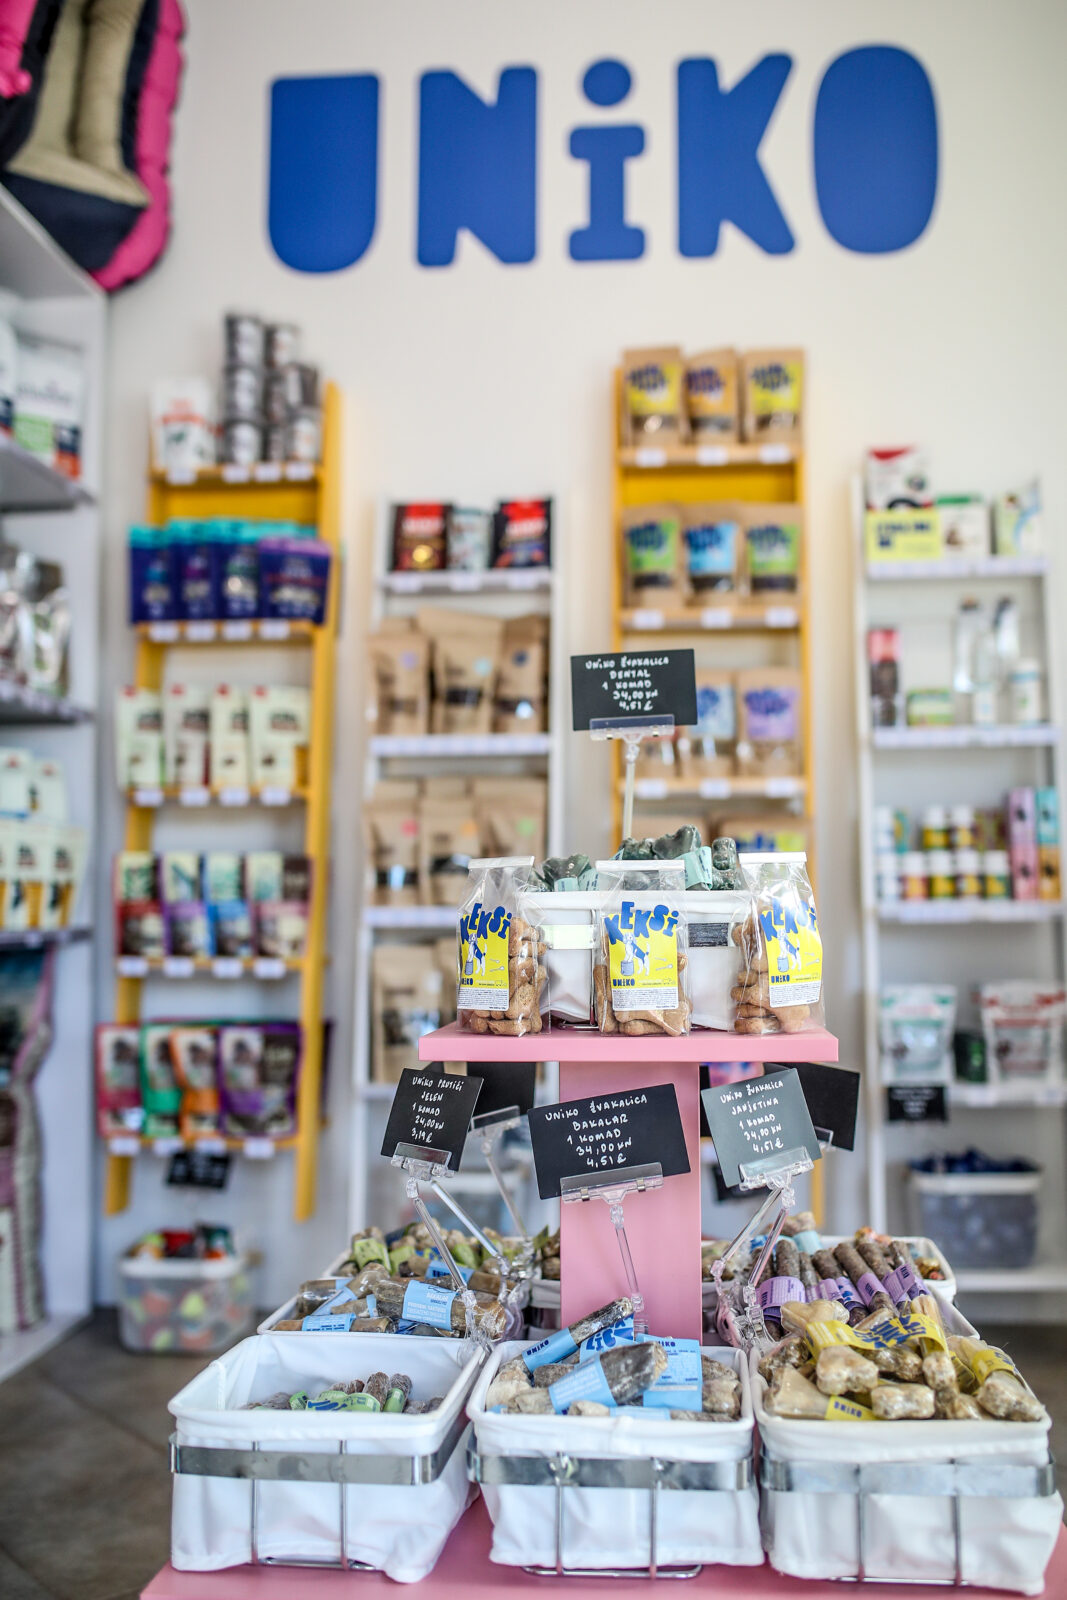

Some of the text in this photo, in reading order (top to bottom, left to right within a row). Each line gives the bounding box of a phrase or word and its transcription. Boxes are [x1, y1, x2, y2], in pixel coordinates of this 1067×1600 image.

[610, 668, 650, 680] DENTAL
[602, 680, 652, 690] 1 KOMAD
[421, 1091, 443, 1101] JELEN
[412, 1102, 440, 1116] 1 KOMAD
[572, 1114, 628, 1131] BAKALAR
[739, 1114, 776, 1130] 1 KOMAD
[566, 1128, 621, 1145] 1 KOMAD
